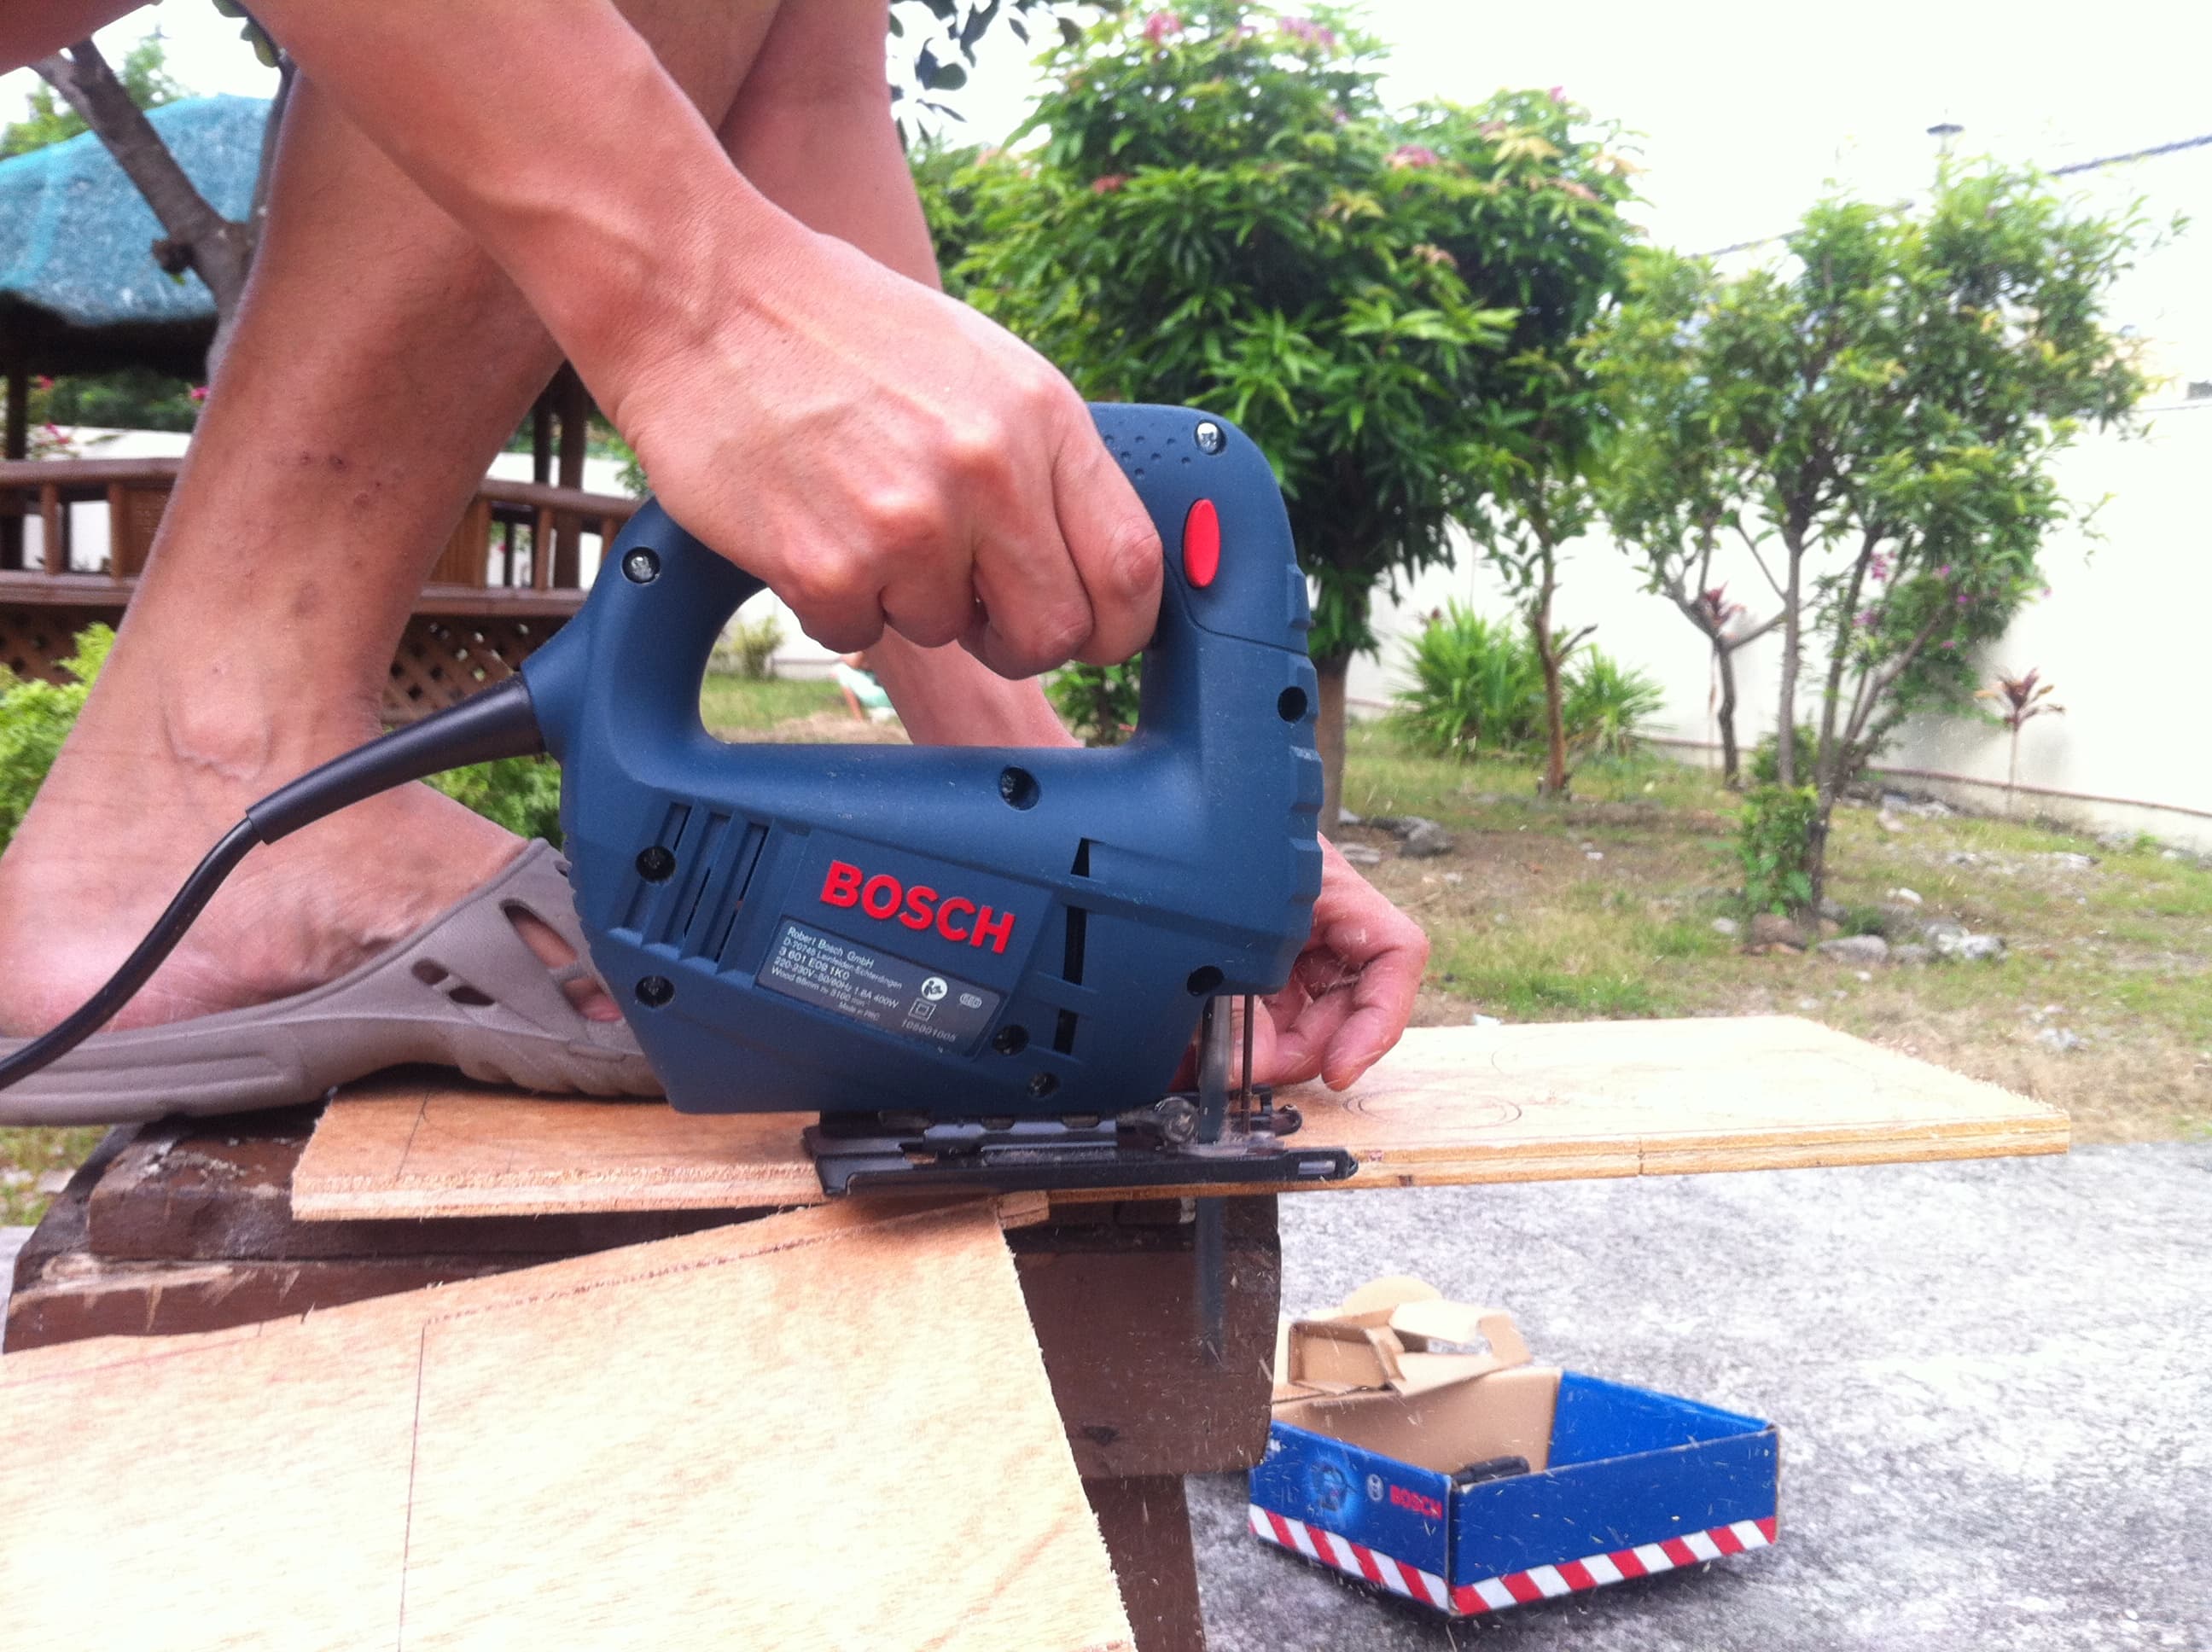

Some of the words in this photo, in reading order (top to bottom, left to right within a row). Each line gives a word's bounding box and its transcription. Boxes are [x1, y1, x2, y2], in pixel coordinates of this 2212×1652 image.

[820, 859, 1016, 955] BOSCH
[778, 946, 787, 956] 3
[787, 926, 816, 945] Robert
[818, 939, 843, 957] Bosch
[847, 951, 875, 969] GmbH
[1389, 1484, 1443, 1521] BOSCH
